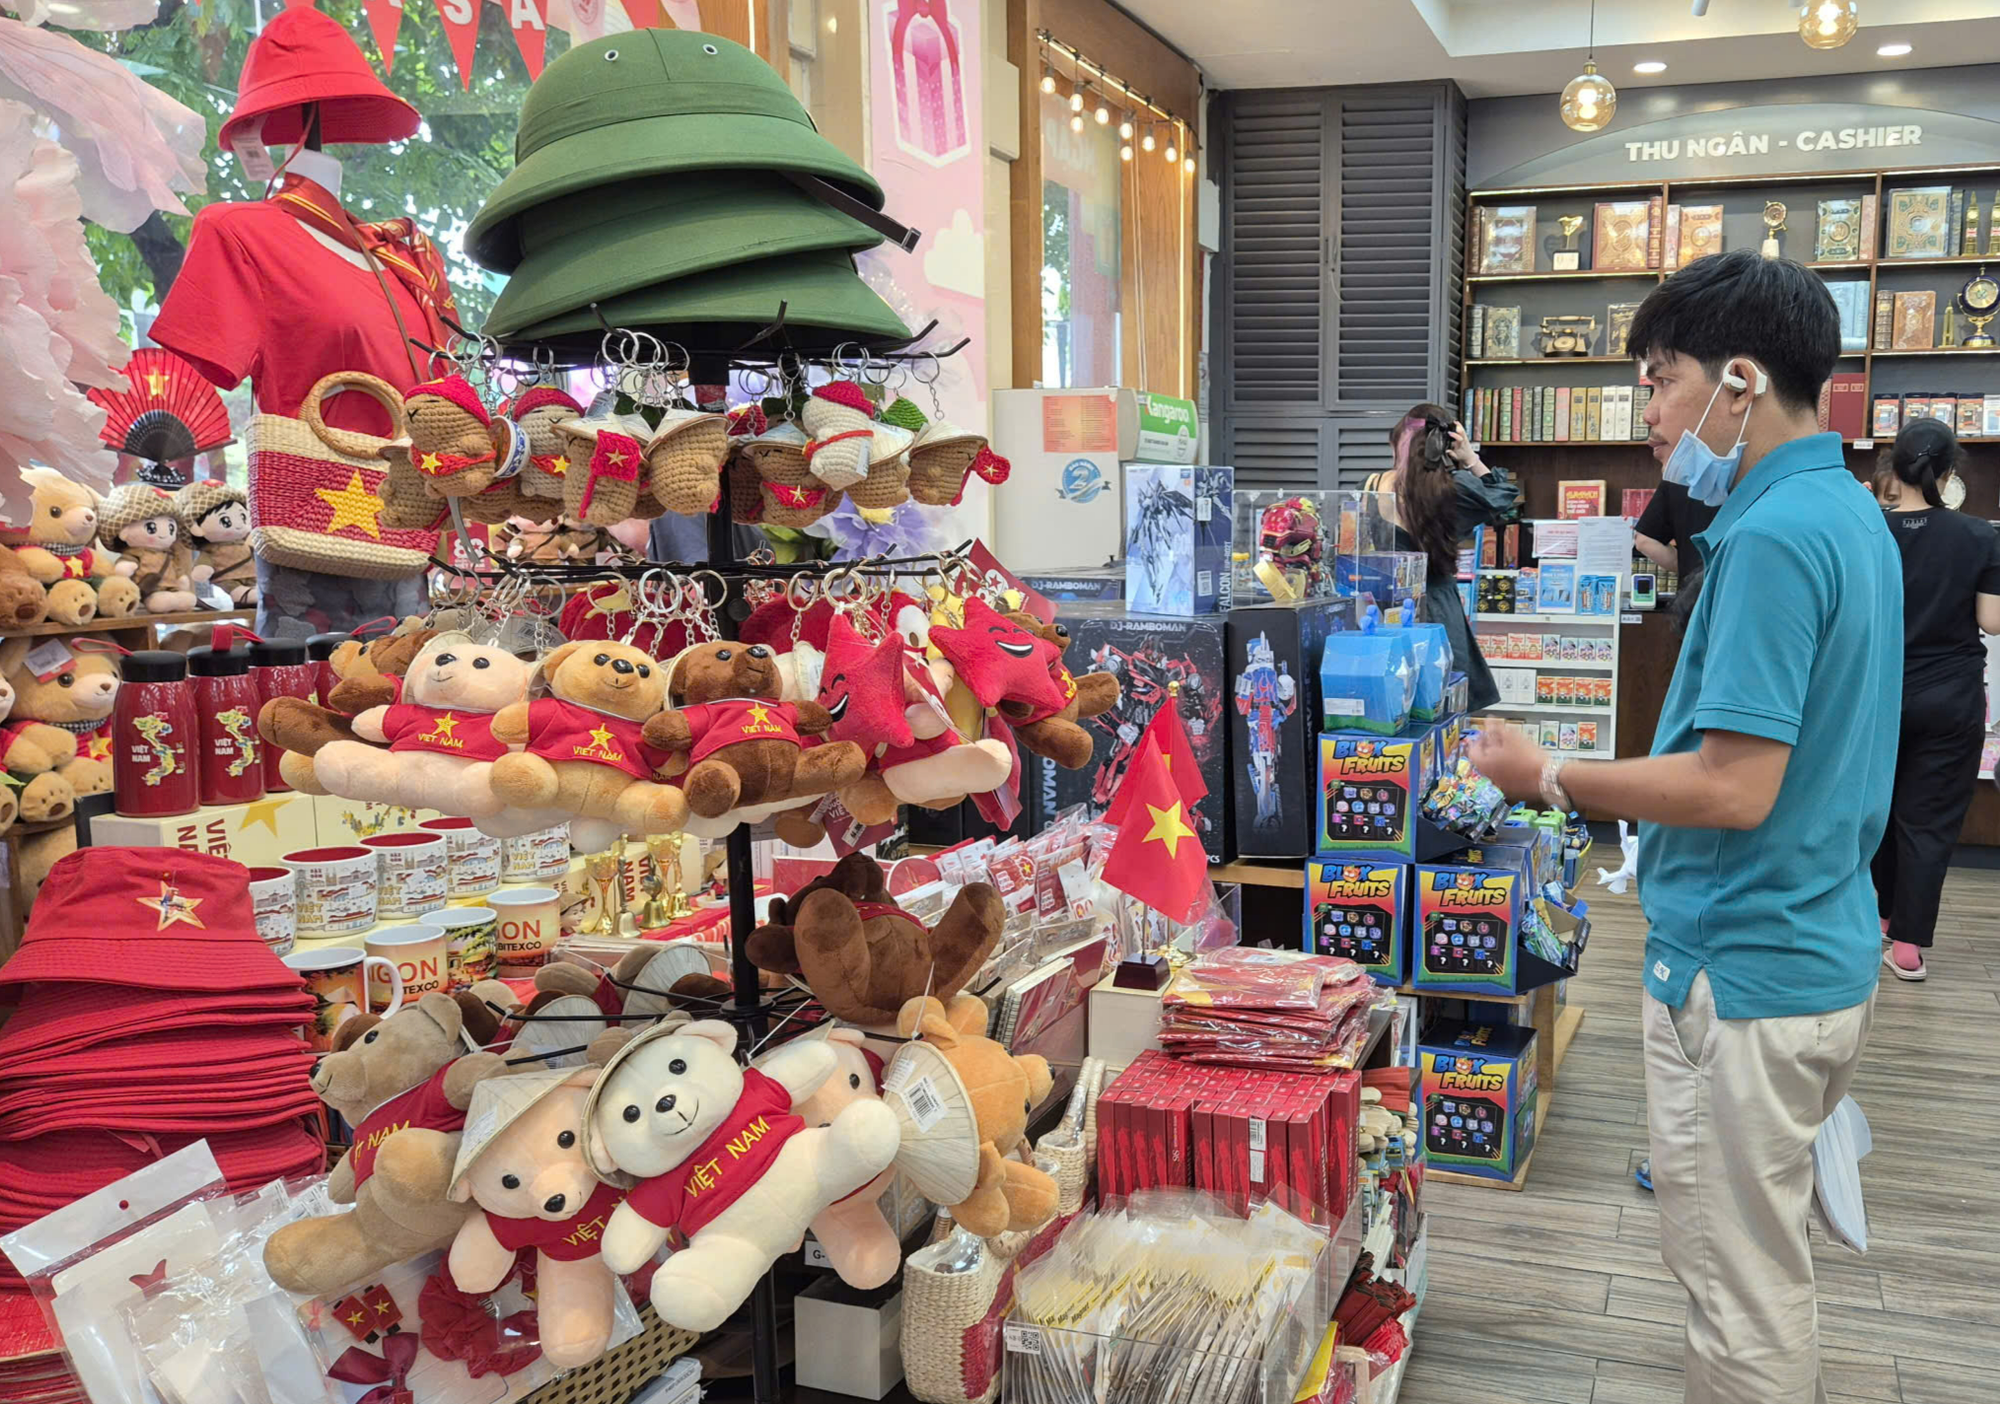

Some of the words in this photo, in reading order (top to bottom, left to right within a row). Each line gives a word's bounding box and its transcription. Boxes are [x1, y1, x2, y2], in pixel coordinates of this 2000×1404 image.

[1625, 141, 1680, 162] THU
[1687, 131, 1769, 159] NGÂN
[1796, 124, 1923, 152] CASHIER
[1031, 580, 1101, 591] DJ-RAMBOMAN
[1218, 572, 1231, 613] FALCON
[1110, 621, 1187, 632] DJ-RAMBOMAN
[214, 747, 234, 755] NAM
[440, 737, 464, 749] NAM
[1333, 738, 1389, 760] BLOX
[131, 754, 151, 763] NAM
[1341, 755, 1407, 776] FRUITS
[1206, 854, 1220, 863] PCS
[623, 860, 635, 902] NAM
[1320, 863, 1375, 883] BLOX
[1432, 870, 1488, 891] BLOX
[1328, 880, 1393, 899] FRUITS
[1440, 887, 1509, 906] FRUITS
[499, 919, 542, 941] ON
[368, 956, 438, 984] IGON
[392, 979, 440, 995] TEXCO
[1432, 1054, 1488, 1074] BLOX
[1440, 1072, 1505, 1092] FRUITS
[684, 1158, 723, 1198] VIỆT
[725, 1115, 771, 1160] NAM
[562, 1215, 606, 1247] VIỆT
